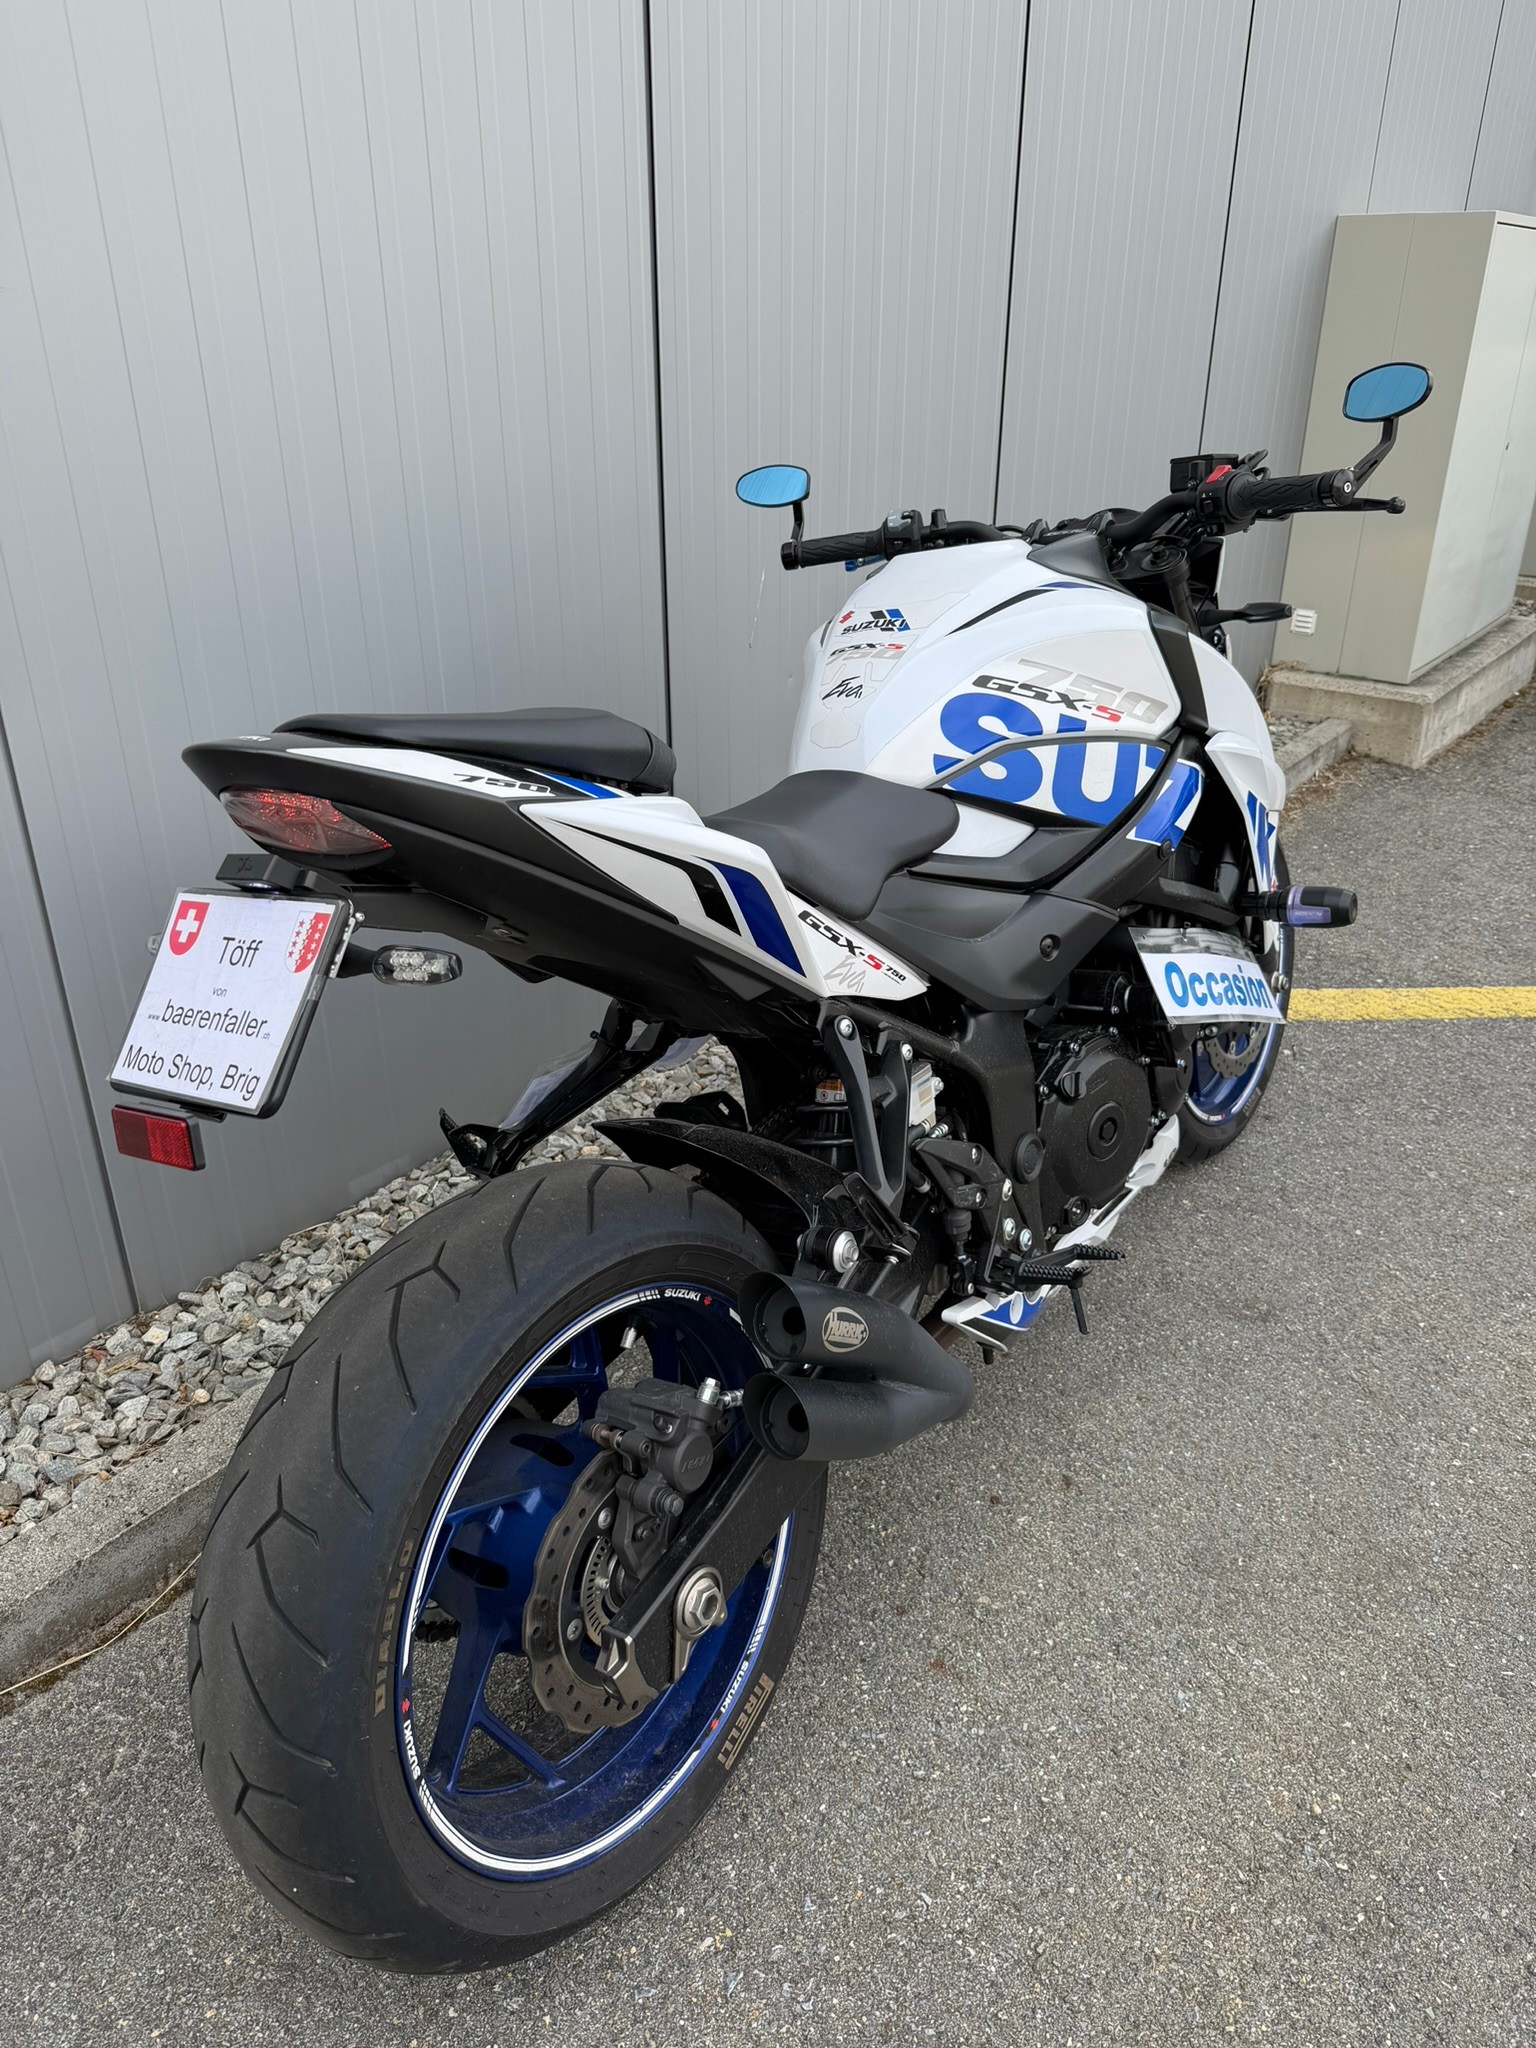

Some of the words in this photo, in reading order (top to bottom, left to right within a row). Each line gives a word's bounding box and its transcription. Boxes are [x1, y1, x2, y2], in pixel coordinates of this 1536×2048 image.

[841, 618, 906, 635] SUZUKI
[972, 674, 1125, 722] GSX-S
[1018, 658, 1169, 724] 750
[453, 773, 550, 793] 750
[219, 936, 263, 968] Töff
[798, 910, 885, 970] GSX-S
[885, 964, 907, 982] 750
[212, 985, 228, 998] von
[1164, 961, 1273, 1010] Occasion
[122, 1044, 165, 1075] Moto
[168, 1053, 214, 1091] Shop,
[220, 1063, 261, 1101] Brig
[664, 1288, 702, 1302] SUZUKI
[719, 1660, 749, 1714] SUZUKI
[717, 1673, 775, 1771] PIRELLI
[403, 1719, 421, 1780] SUZUKI
